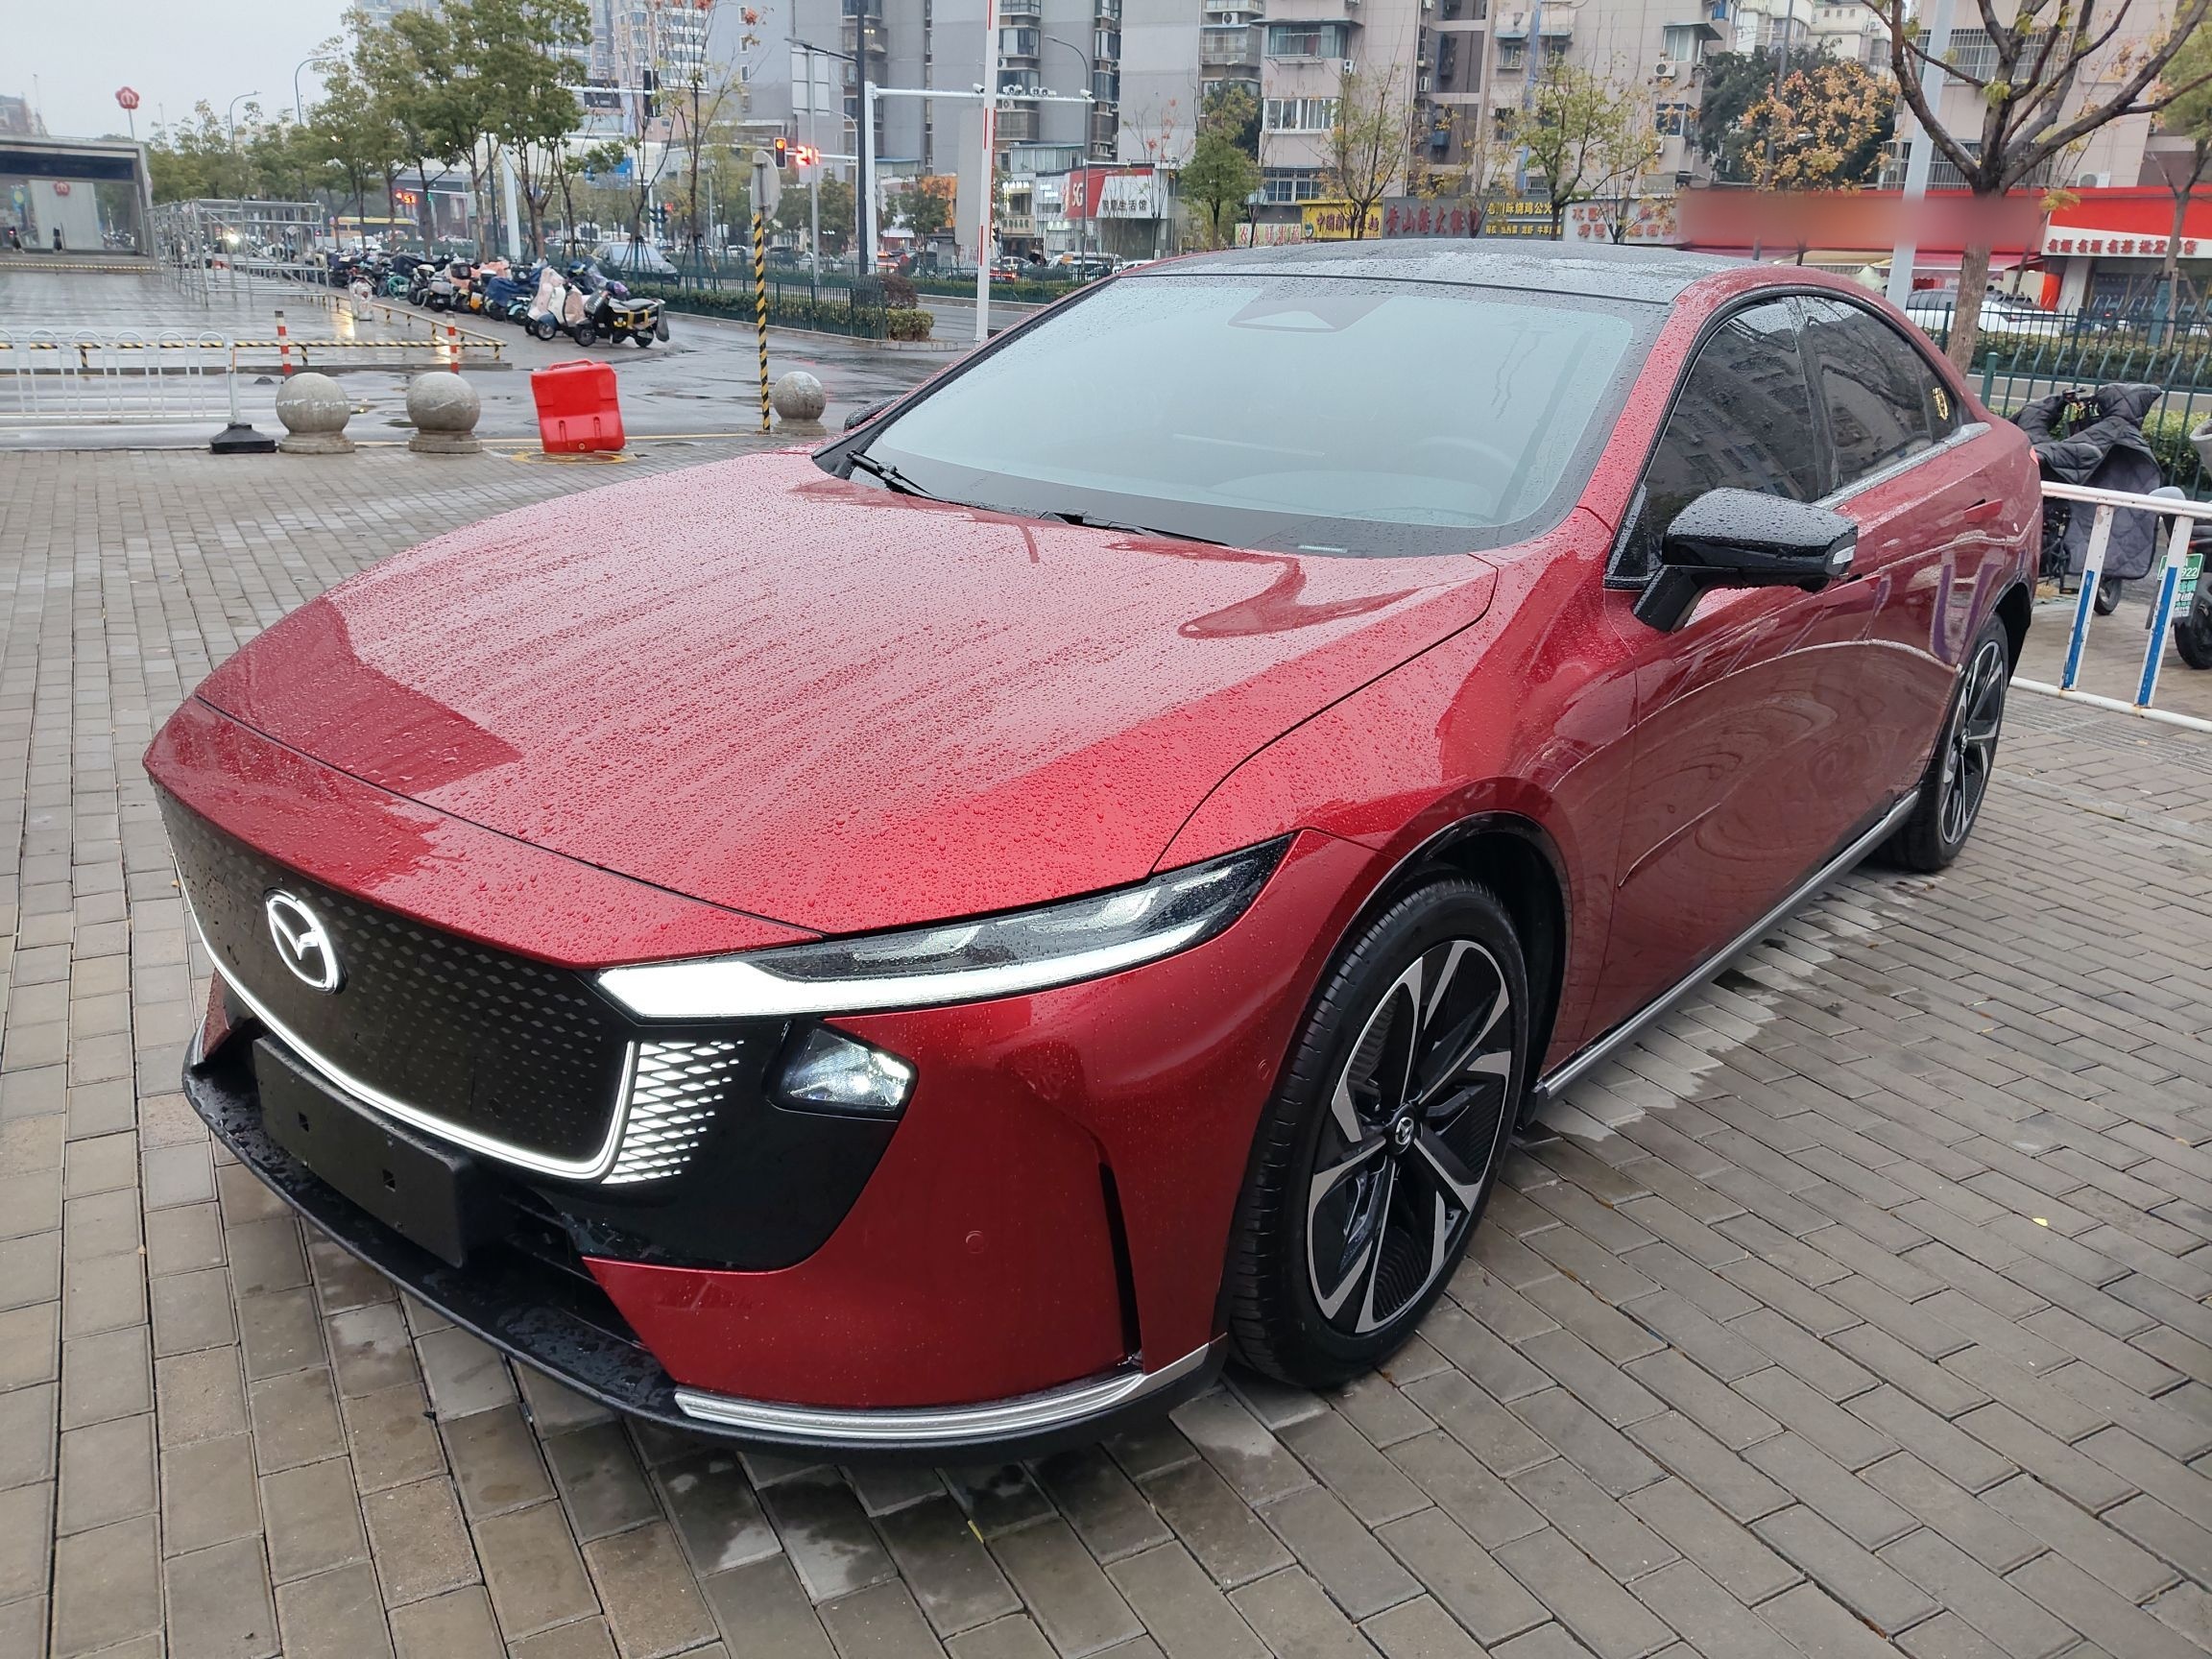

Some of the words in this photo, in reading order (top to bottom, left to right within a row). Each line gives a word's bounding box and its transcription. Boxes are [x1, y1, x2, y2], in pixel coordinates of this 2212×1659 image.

[1072, 181, 1084, 207] 5G
[1487, 202, 1563, 215] 老川味烧鸡公火
